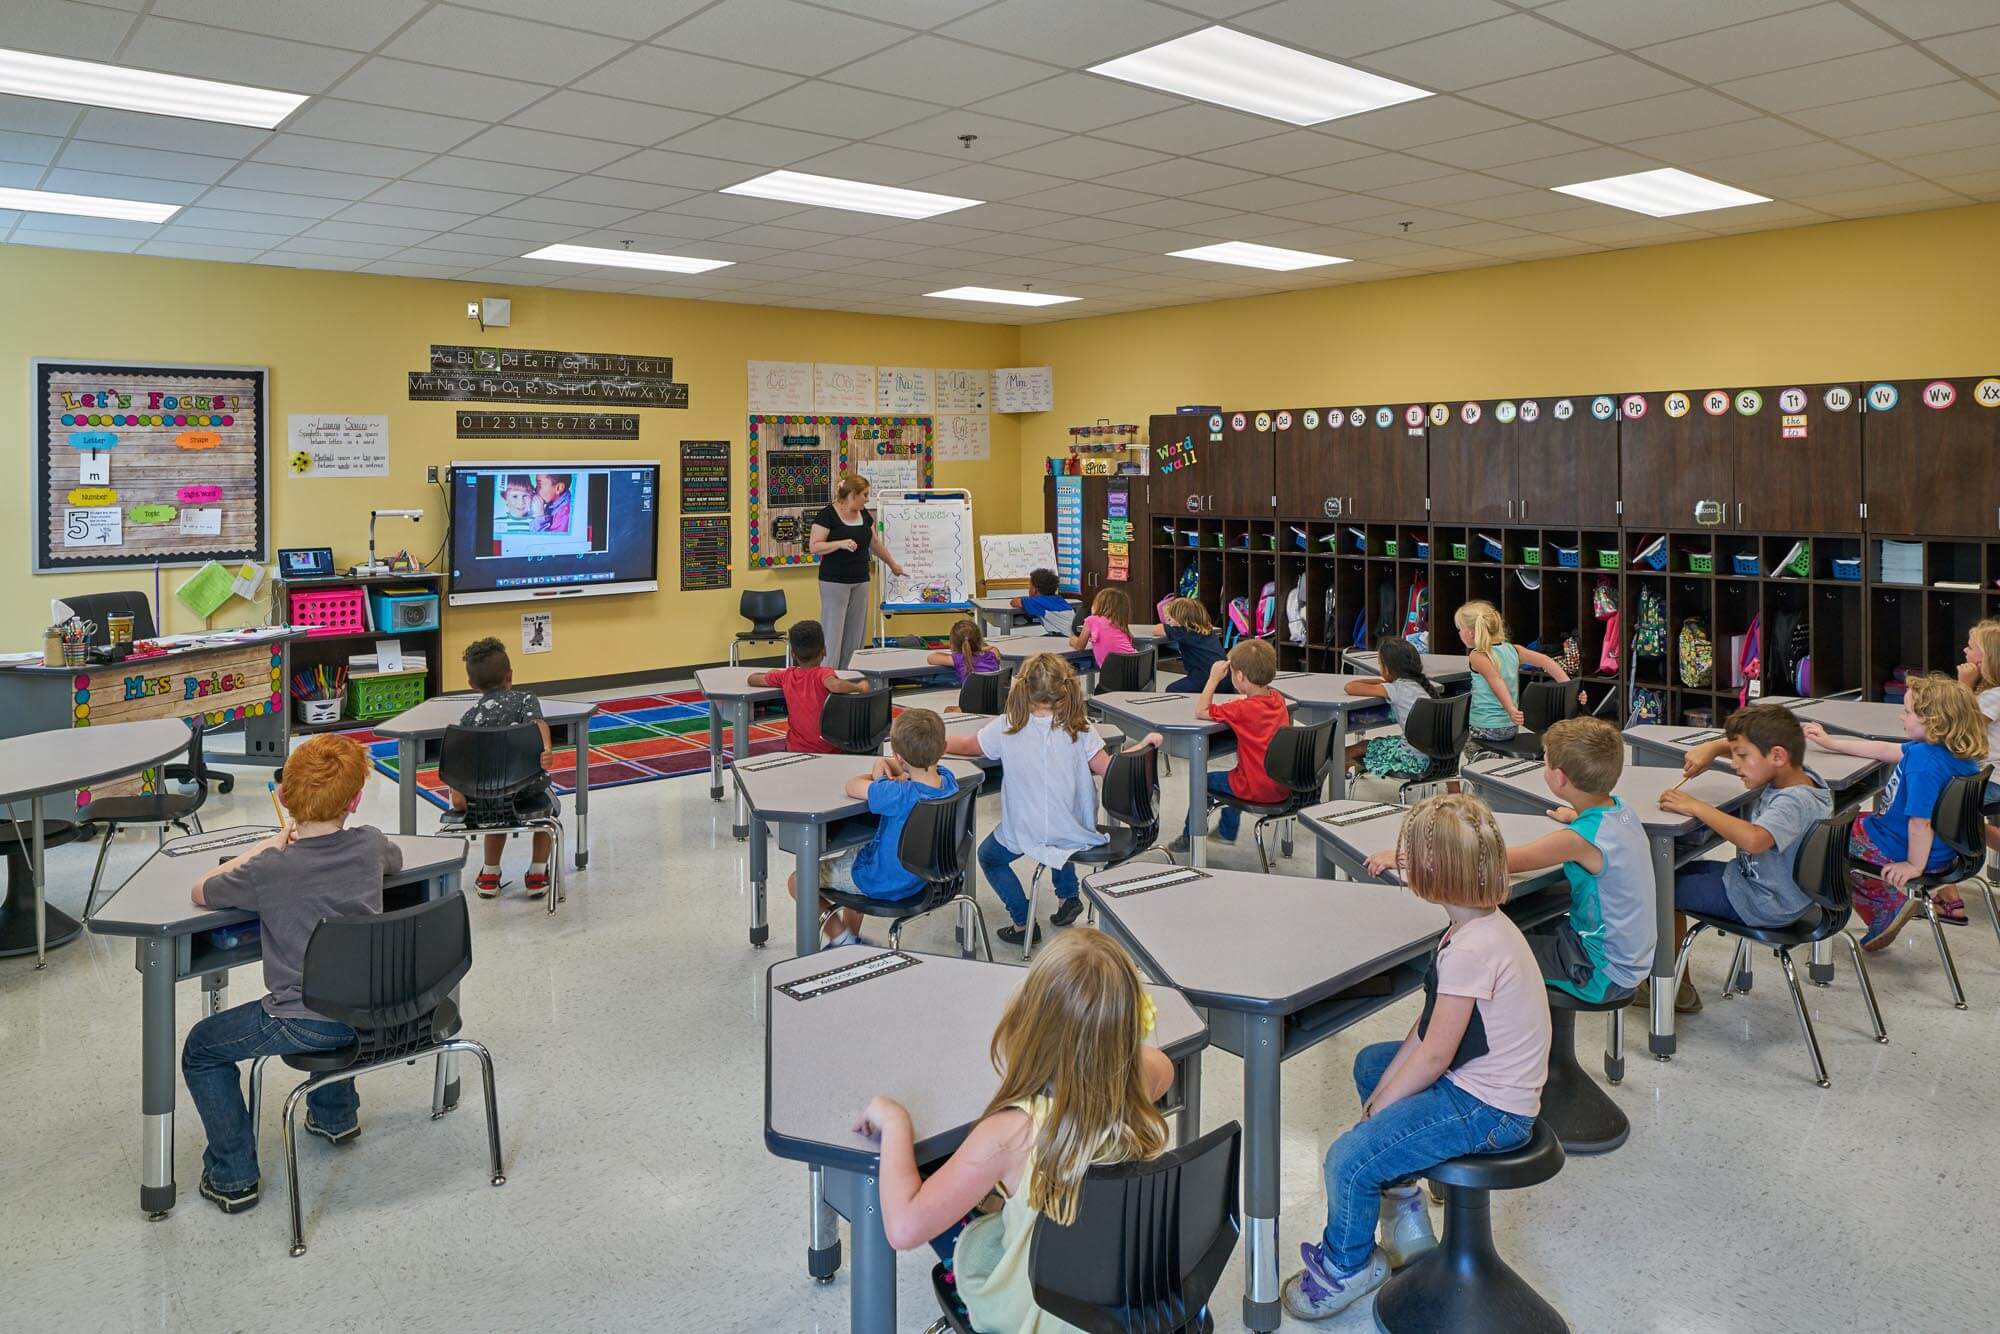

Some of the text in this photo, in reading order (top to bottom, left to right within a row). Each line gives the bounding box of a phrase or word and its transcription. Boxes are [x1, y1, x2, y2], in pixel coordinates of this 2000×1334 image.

[432, 352, 452, 363] Aa
[457, 352, 474, 364] Bb
[502, 354, 518, 366] Dd
[524, 355, 538, 367] Ee
[544, 356, 557, 368] Ff
[562, 357, 579, 373] Gg
[585, 358, 600, 370] Hh
[605, 359, 612, 371] Ii
[618, 360, 630, 375] Jj
[637, 361, 650, 372] Kk
[656, 362, 666, 373] Ll
[410, 378, 687, 402] Mm Nn Oo Pp Qq Rr Ss Tt Uu Vv Ww Xx Yy Zz
[1010, 375, 1026, 388] Mm
[61, 388, 132, 411] Let's
[1258, 418, 1267, 427] Cc
[1279, 416, 1288, 425] Dd
[1306, 415, 1315, 425] Ee
[1331, 414, 1339, 424] Ff
[1352, 412, 1363, 424] Gg
[1435, 408, 1443, 421] Jj
[1465, 408, 1476, 418] Kk
[1595, 402, 1610, 413] Oo
[1629, 402, 1642, 415] Pp
[1668, 399, 1686, 410] Qq
[1711, 397, 1722, 409] Rr
[1742, 396, 1755, 409] Ss
[1786, 395, 1799, 407] Tt
[1831, 393, 1845, 406] Uu
[1875, 391, 1890, 403] Vv
[1929, 389, 1950, 402] Ww
[1983, 386, 2000, 400] Xx
[462, 417, 472, 428] 0
[493, 417, 500, 428] 2
[508, 417, 516, 428] 3
[525, 417, 533, 428] 4
[541, 417, 549, 428] 5
[557, 418, 564, 429] 6
[571, 418, 579, 429] 7
[589, 418, 596, 429] 8
[605, 419, 612, 430] 9
[621, 419, 633, 430] 10
[1786, 416, 1800, 425] the
[83, 436, 106, 445] Letter
[854, 426, 903, 440] Anchor
[876, 442, 923, 456] Charts
[1156, 435, 1193, 460] Word
[1161, 450, 1198, 475] wall
[89, 472, 100, 481] m
[81, 493, 108, 501] Number
[67, 511, 89, 540] 5
[124, 671, 245, 700] Mrs Price
